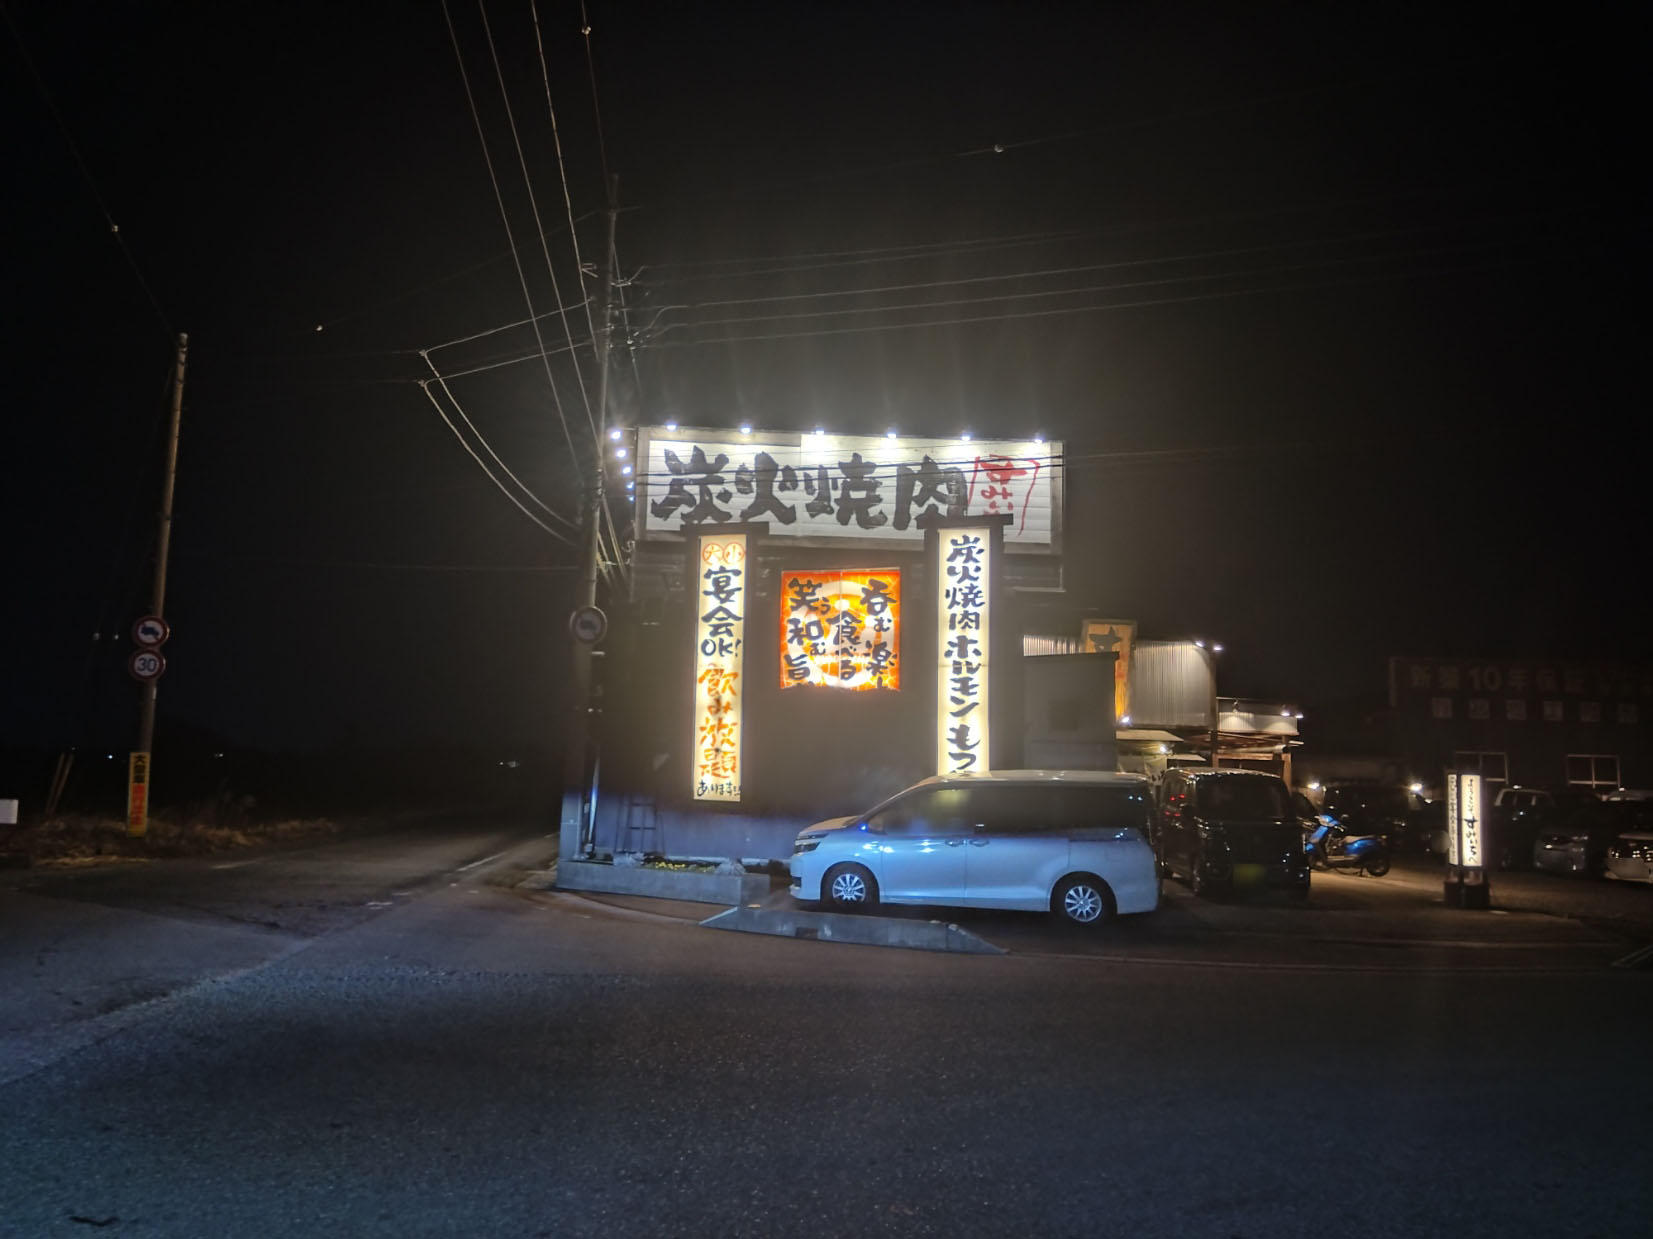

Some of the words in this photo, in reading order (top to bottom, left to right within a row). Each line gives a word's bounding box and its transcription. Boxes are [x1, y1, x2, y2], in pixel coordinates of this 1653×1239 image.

[650, 445, 969, 530] 炭火焼肉
[980, 460, 1028, 515] すみい
[136, 657, 158, 673] 30
[826, 610, 862, 681] 食べる
[943, 535, 986, 776] 炭火焼肉ホルモンもつ
[698, 667, 740, 779] 飲み放題
